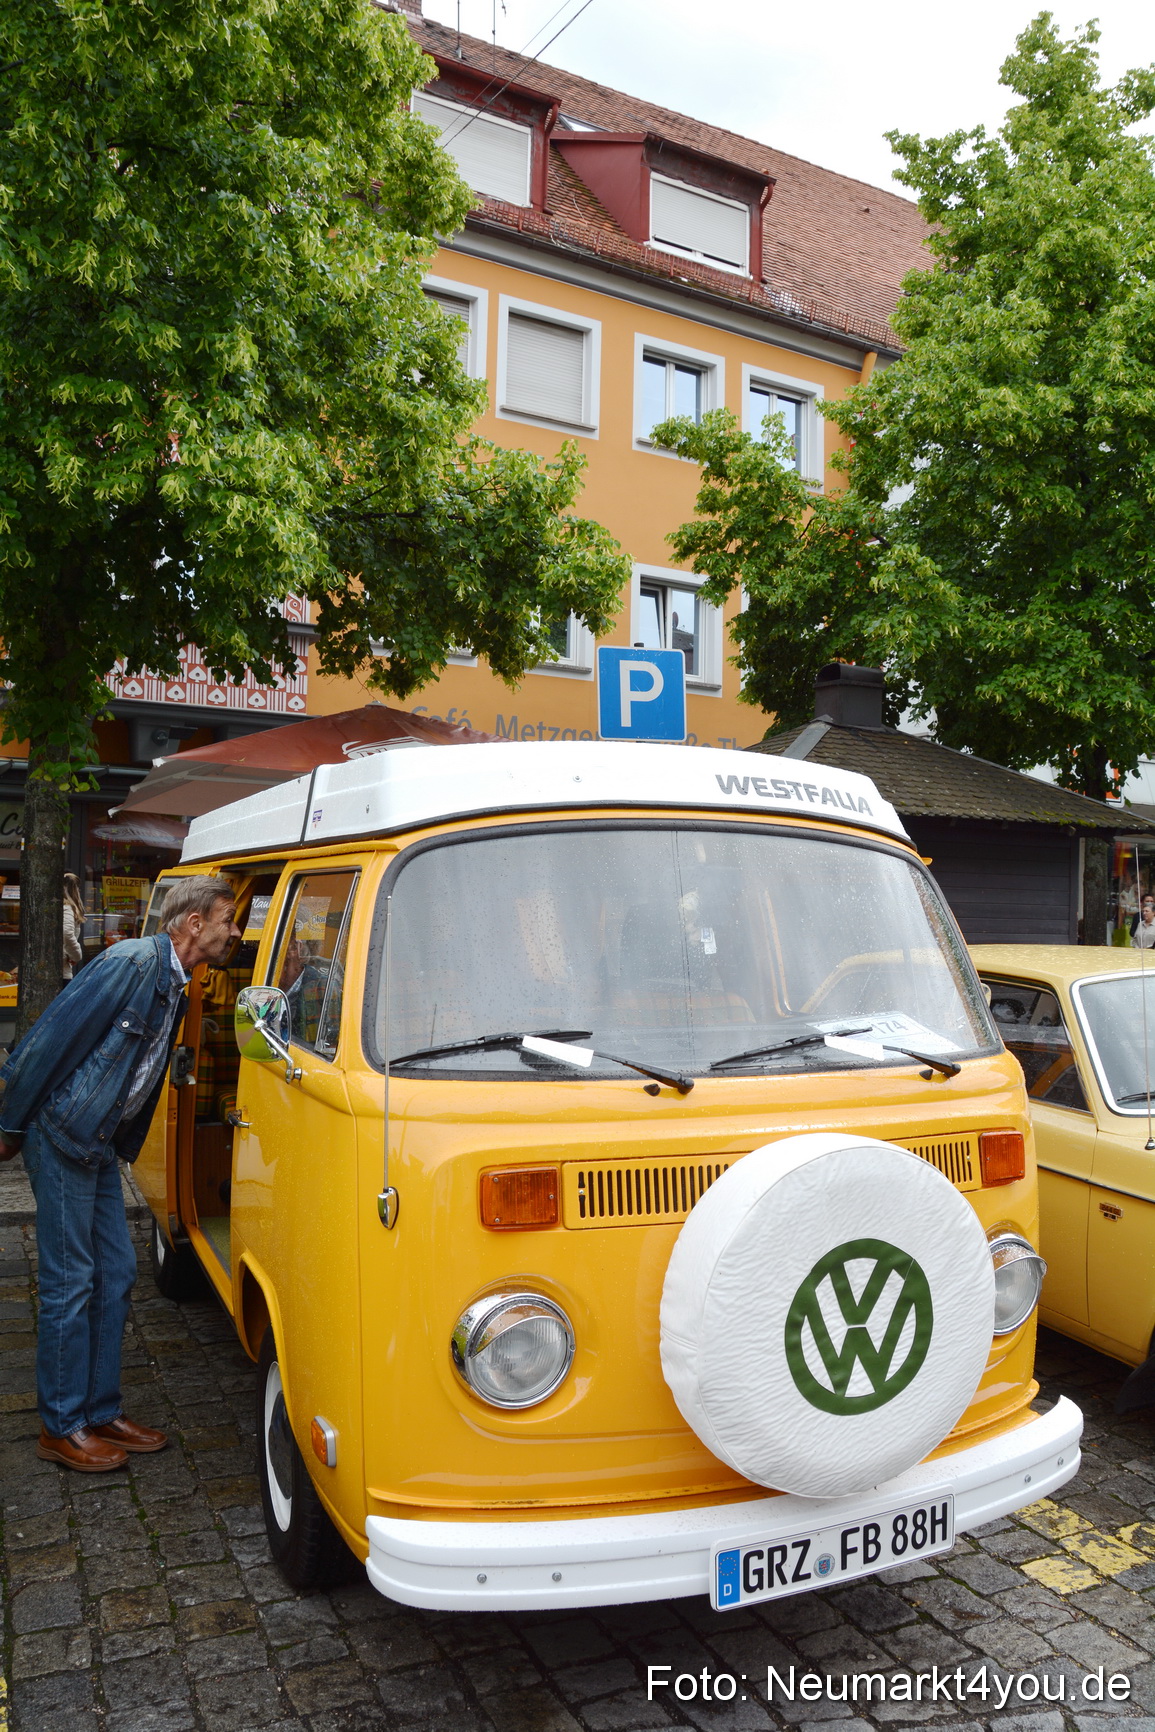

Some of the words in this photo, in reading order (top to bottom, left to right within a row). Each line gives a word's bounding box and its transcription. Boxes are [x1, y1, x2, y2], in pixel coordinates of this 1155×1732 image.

[619, 660, 664, 727] P
[715, 774, 873, 816] WESTFALIA
[790, 1243, 929, 1411] VW
[742, 1538, 811, 1593] GRZ
[840, 1522, 881, 1570] FB
[891, 1502, 948, 1556] 88H
[723, 1583, 732, 1596] D
